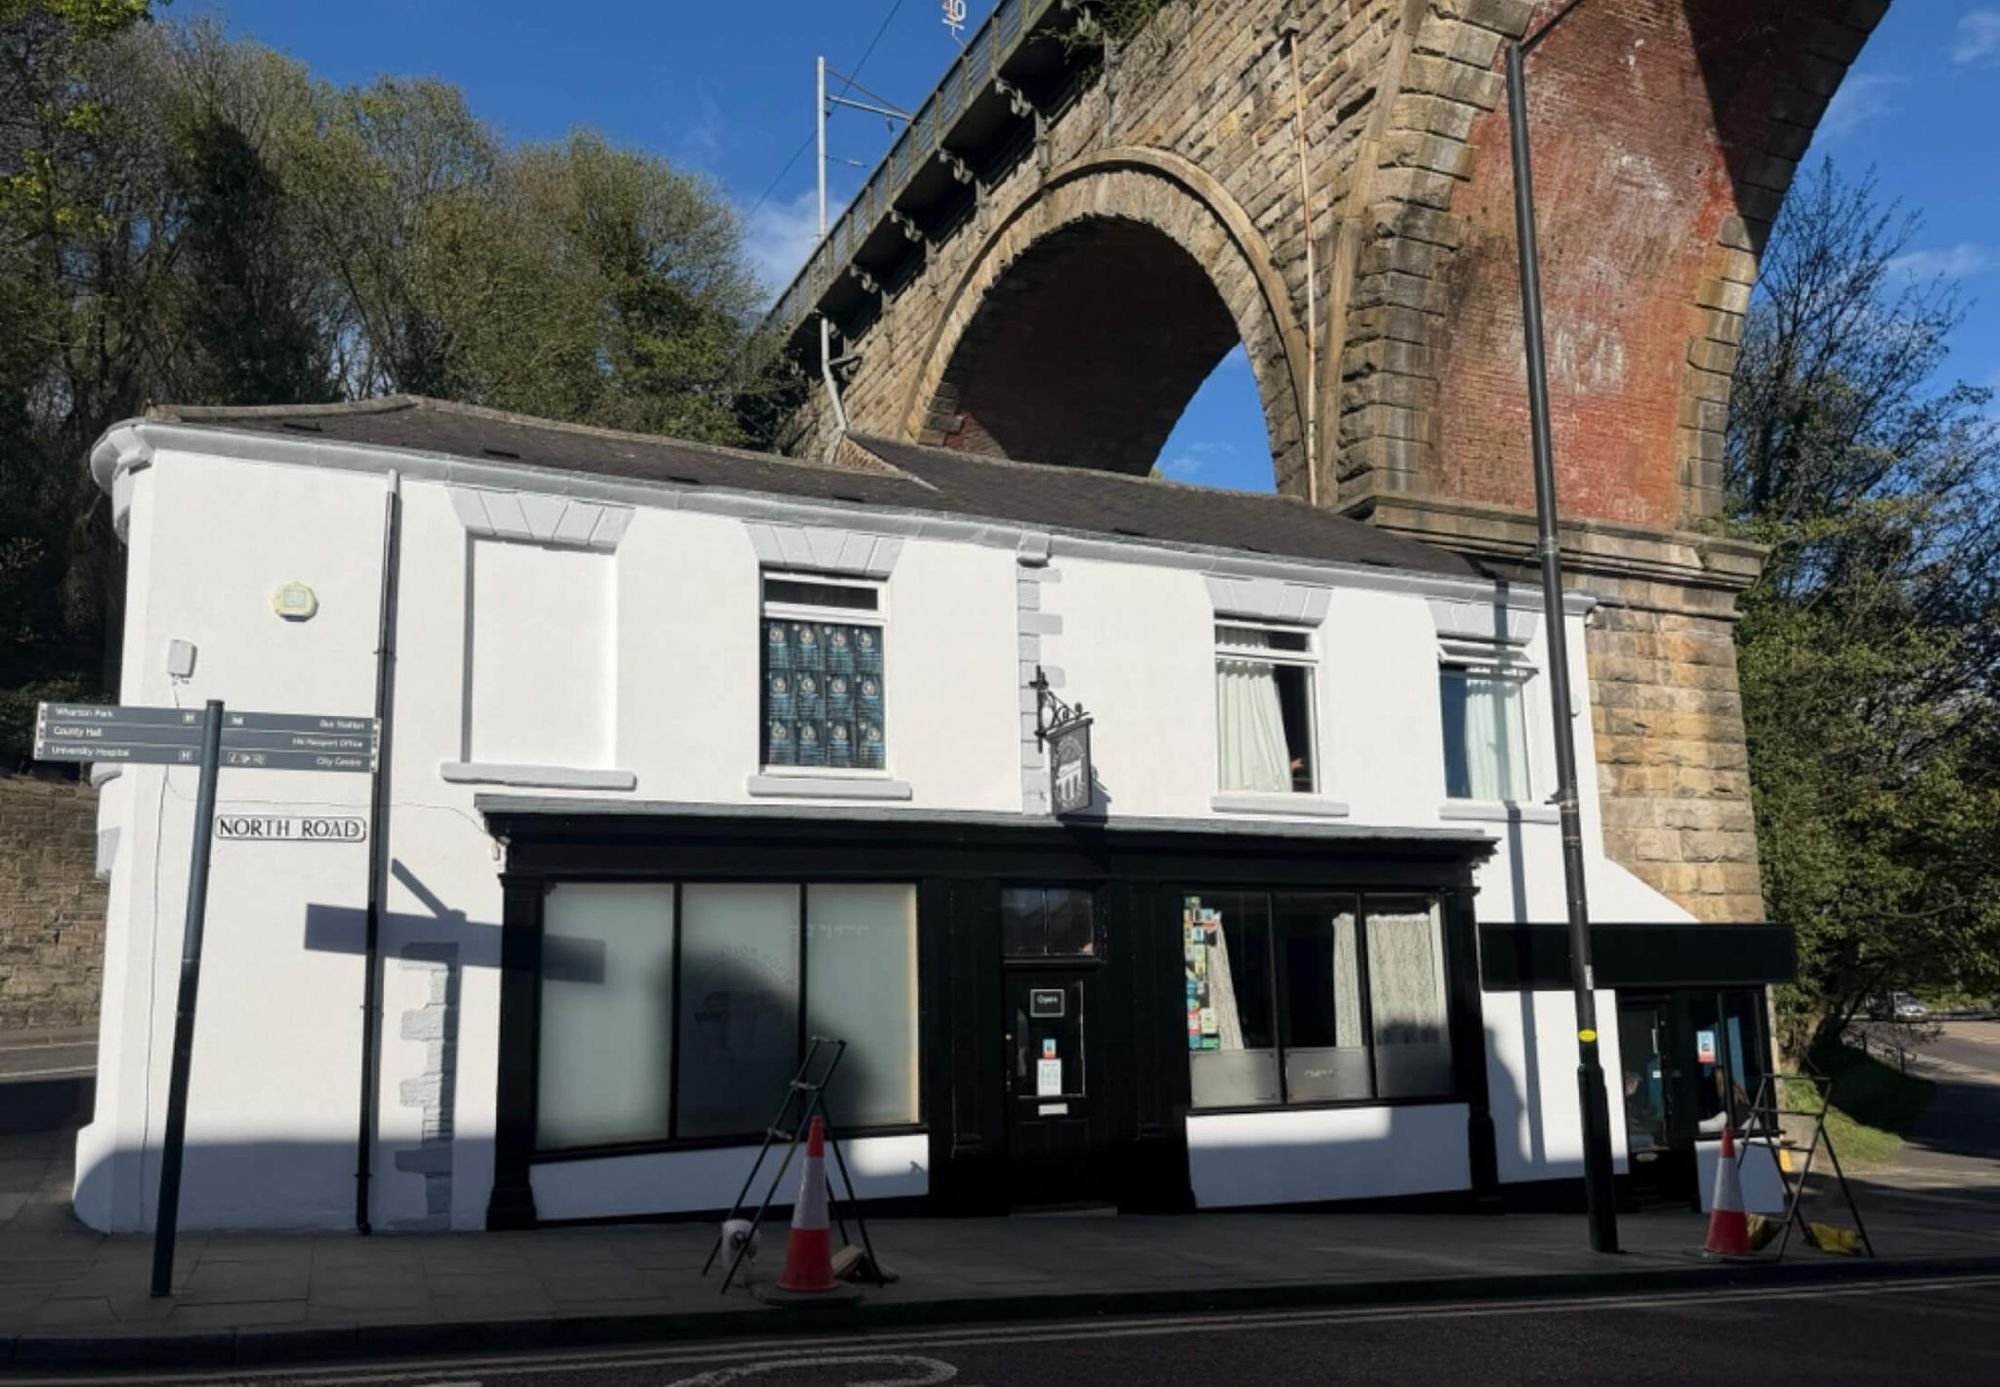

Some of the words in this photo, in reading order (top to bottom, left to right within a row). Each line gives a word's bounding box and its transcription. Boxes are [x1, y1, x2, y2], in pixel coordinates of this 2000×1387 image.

[56, 708, 92, 718] Wharton
[96, 711, 113, 719] Park
[54, 726, 84, 738] County
[86, 728, 103, 738] Hall
[341, 740, 364, 750] Office
[52, 746, 93, 758] University
[96, 750, 130, 759] Hospital
[317, 757, 333, 768] City
[336, 759, 362, 768] Centre
[220, 818, 290, 836] NORTH
[301, 819, 361, 837] ROAD
